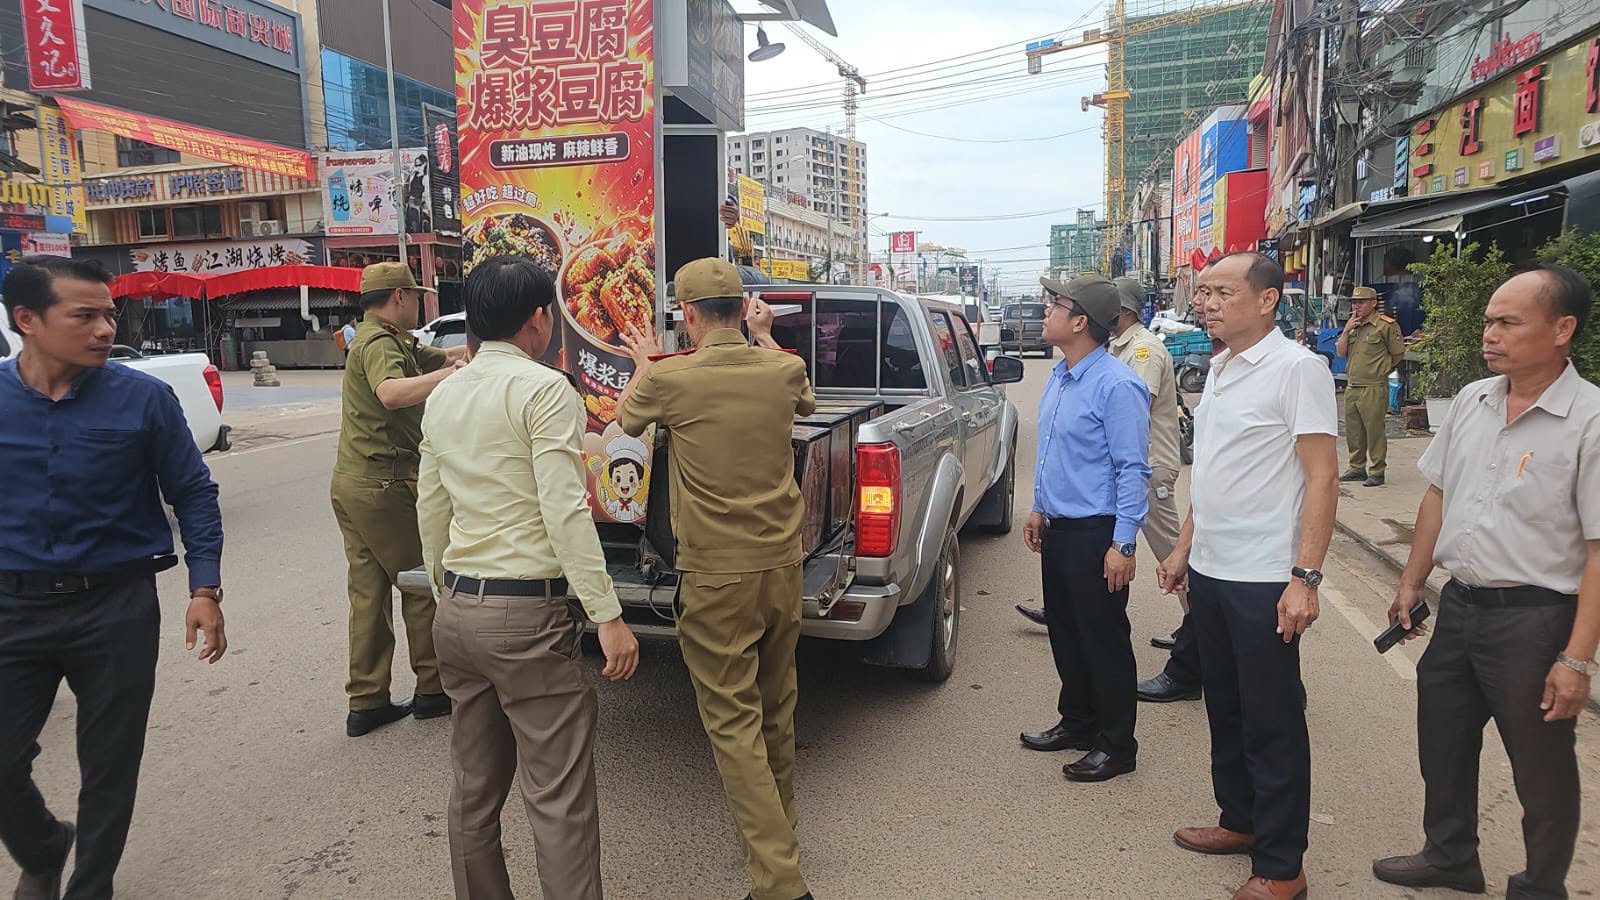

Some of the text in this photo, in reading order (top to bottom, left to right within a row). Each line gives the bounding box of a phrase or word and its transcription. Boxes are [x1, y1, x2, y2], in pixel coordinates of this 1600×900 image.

[480, 0, 629, 68] 臭豆腐
[469, 60, 647, 129] 爆浆豆腐
[501, 138, 618, 163] 新油现炸 麻辣鲜香
[84, 178, 152, 202] 抵押贷款
[169, 170, 243, 195] 护照签证
[463, 186, 499, 211] 超好吃
[152, 243, 285, 272] 烤鱼 江湖烧烤
